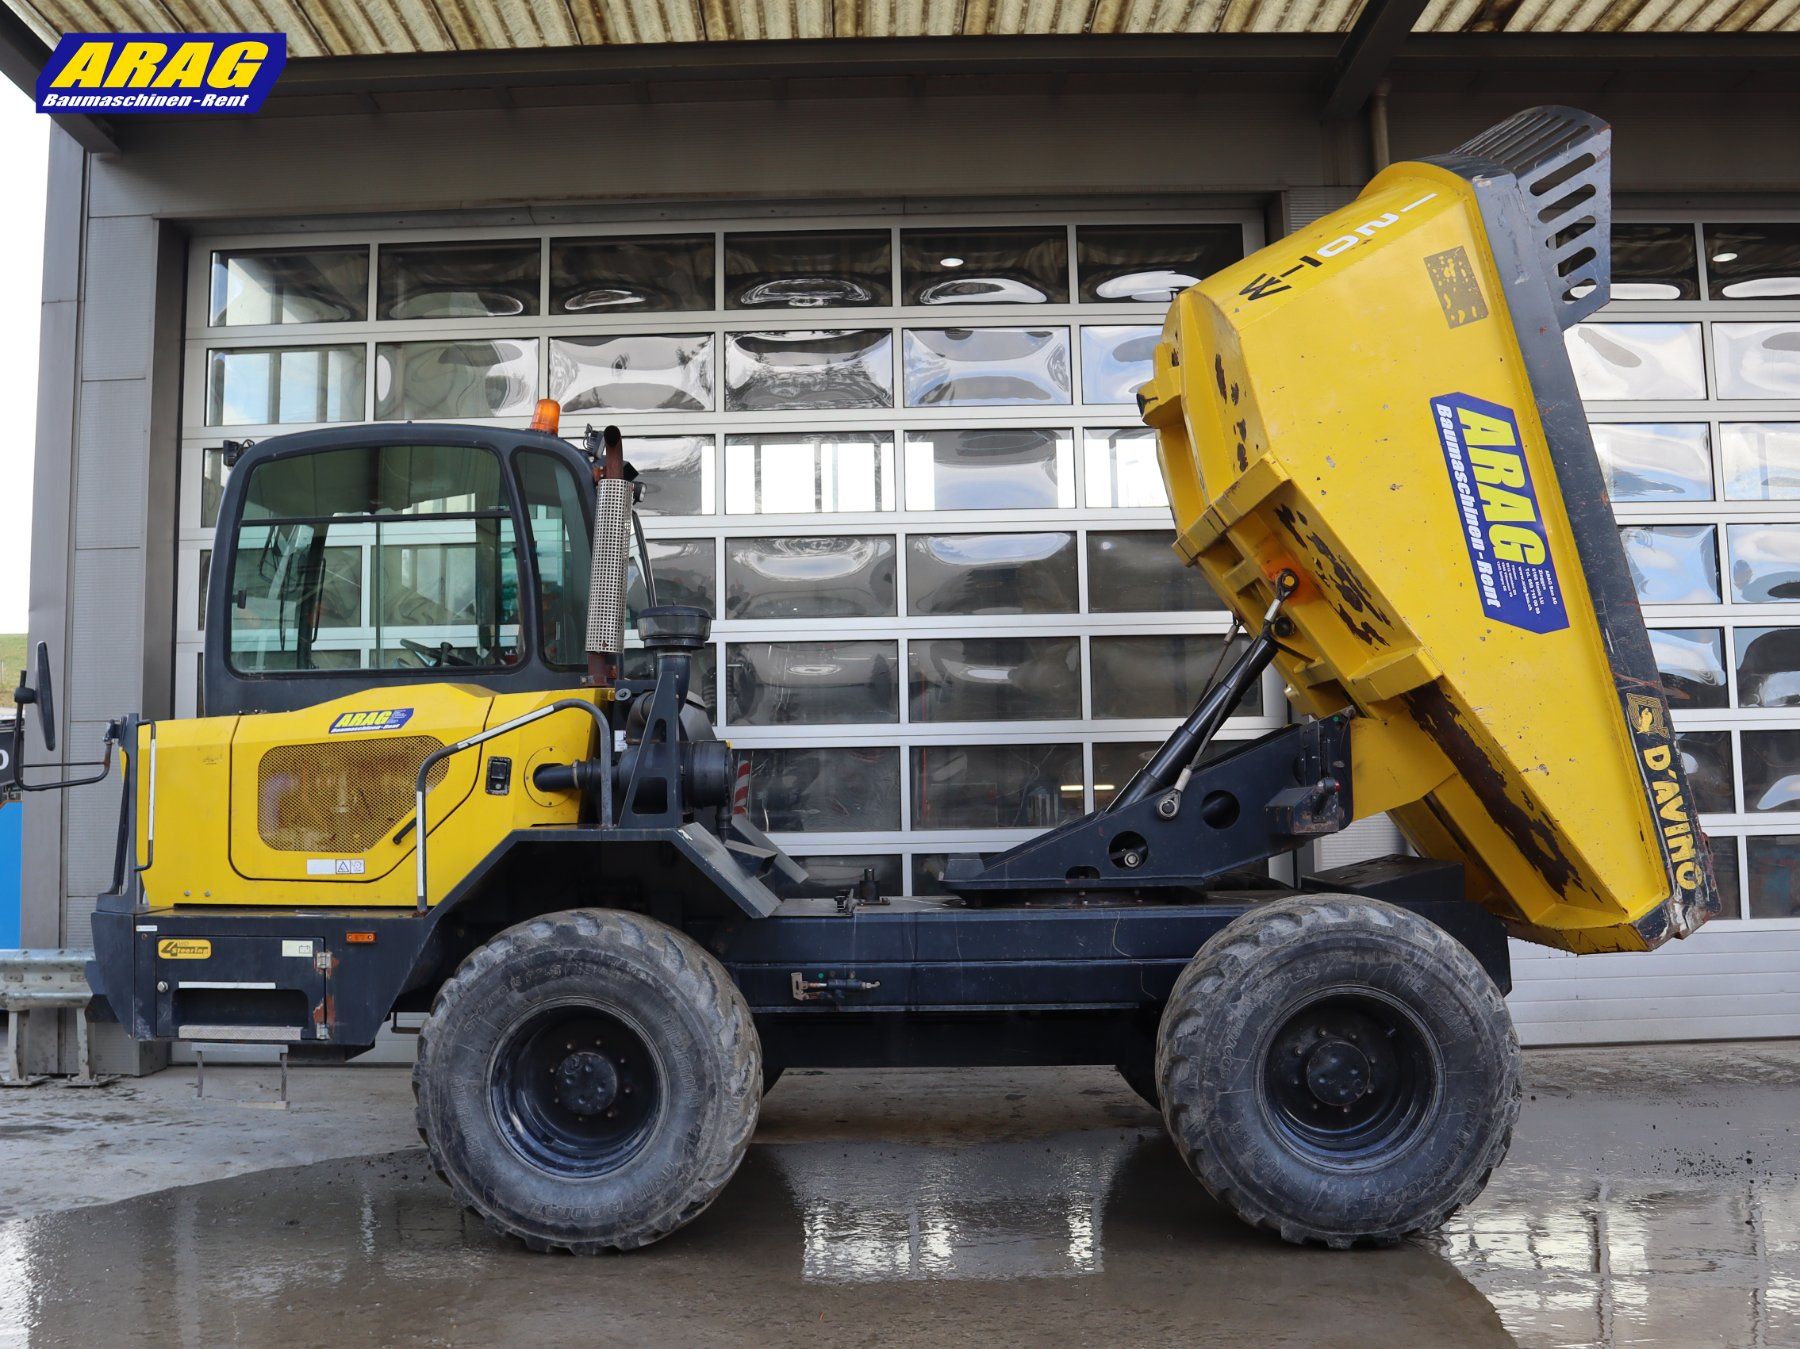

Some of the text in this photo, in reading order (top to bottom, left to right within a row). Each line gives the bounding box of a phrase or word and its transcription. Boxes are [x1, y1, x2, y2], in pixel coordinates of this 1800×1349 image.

[1436, 404, 1501, 608] Baumaschinen-Rent
[1457, 408, 1546, 564] ARAG
[335, 711, 392, 727] ARAG
